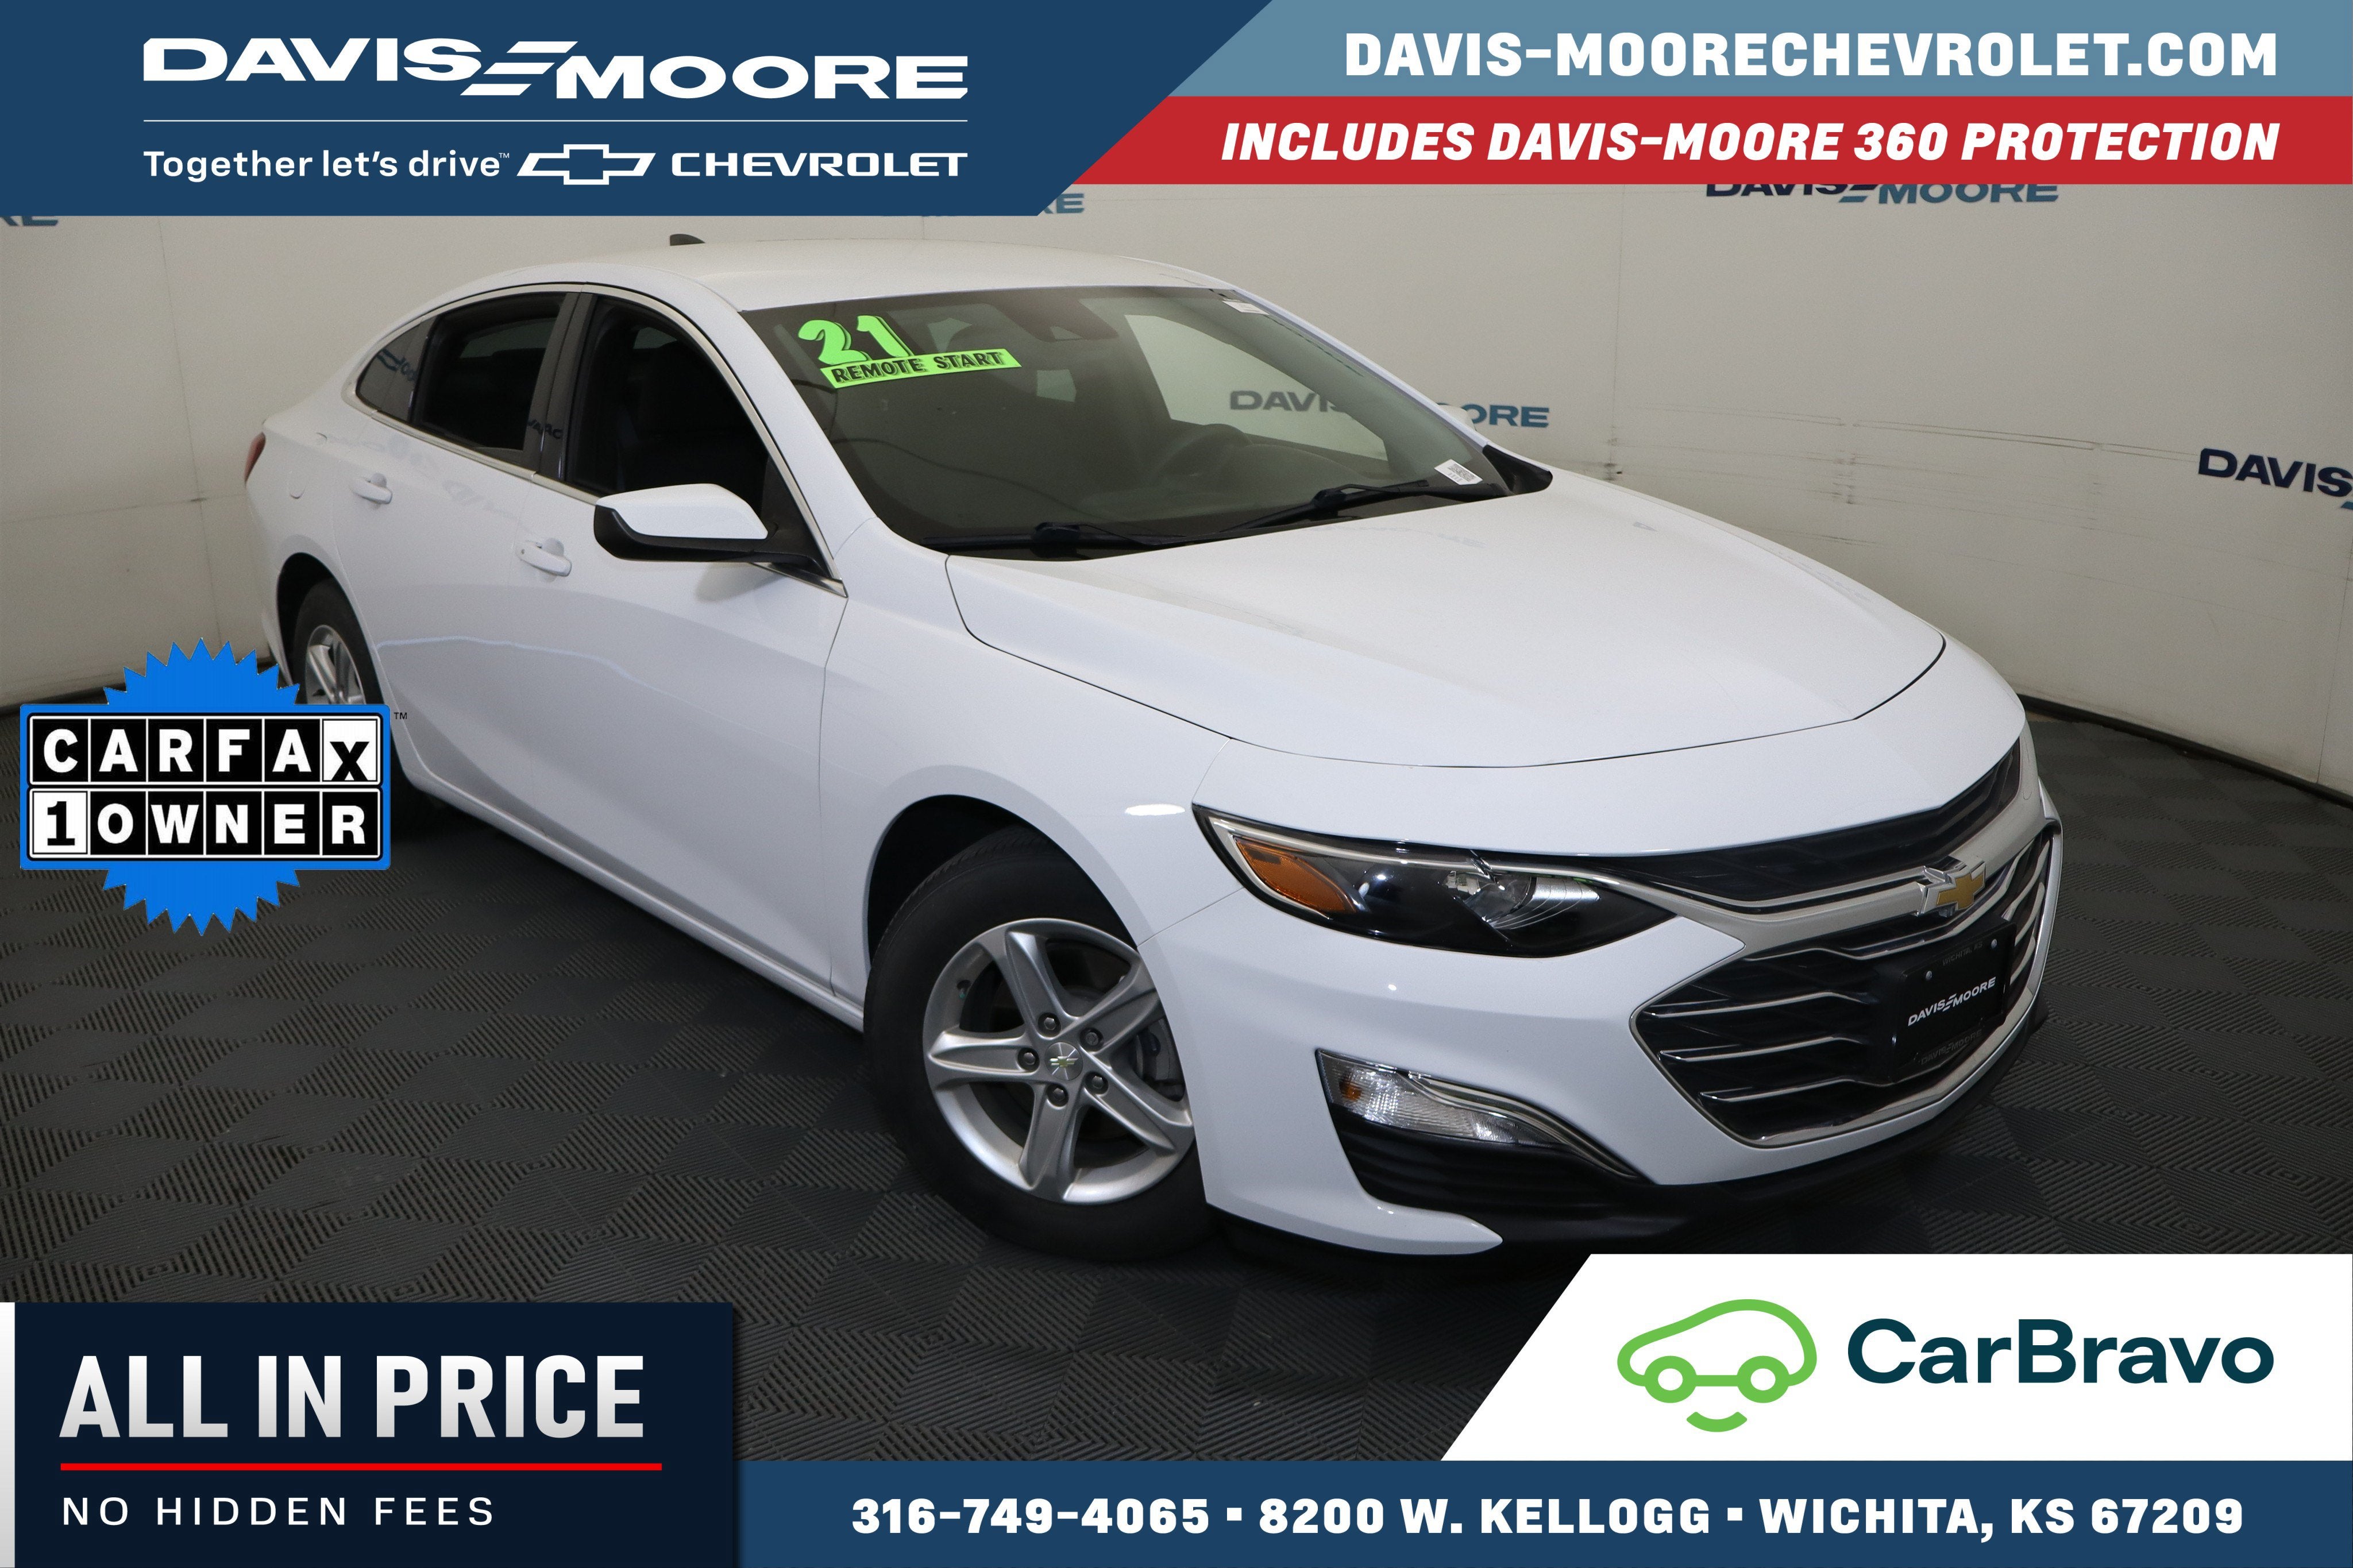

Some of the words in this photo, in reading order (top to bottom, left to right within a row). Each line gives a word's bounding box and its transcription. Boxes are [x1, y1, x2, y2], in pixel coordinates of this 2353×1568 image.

[798, 315, 914, 365] 21
[831, 358, 925, 383] REMOTE
[934, 351, 1005, 370] START
[1230, 391, 1346, 412] DAVI
[2198, 448, 2353, 497] DAVIS
[1908, 999, 1946, 1026] DAVIS
[1953, 976, 1996, 1007] MOORE
